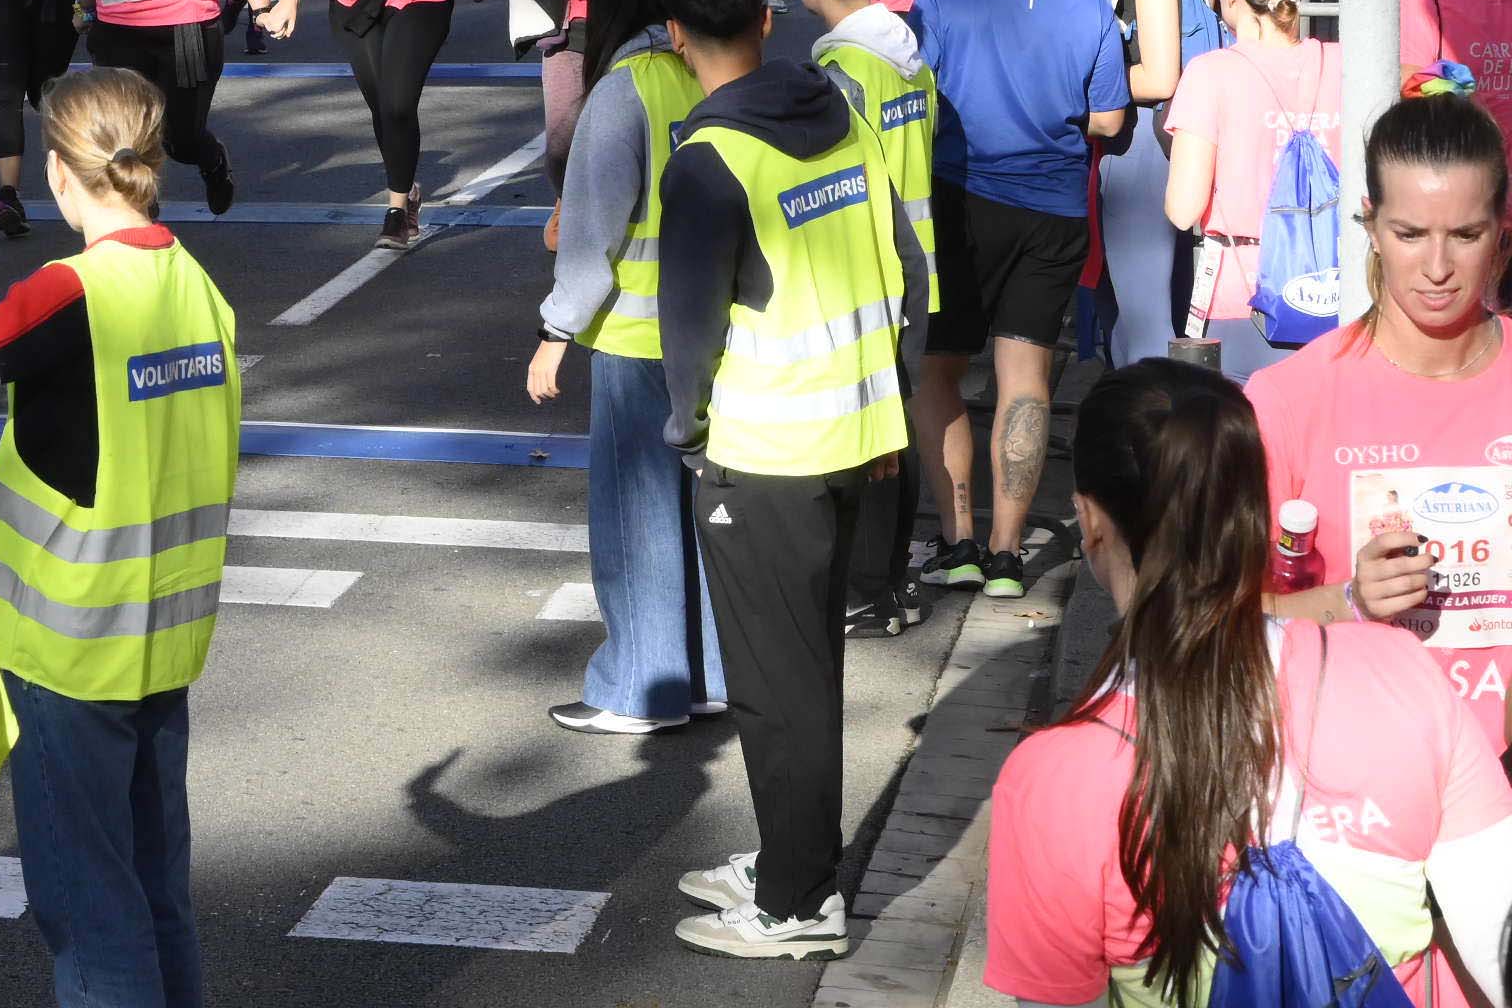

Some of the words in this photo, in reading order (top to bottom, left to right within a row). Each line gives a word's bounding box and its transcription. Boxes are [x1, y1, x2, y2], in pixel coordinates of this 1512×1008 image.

[782, 175, 867, 219] VOLUNTARIS
[131, 354, 223, 390] VOLUNTARIS
[1335, 443, 1421, 466] OYSHO
[1420, 498, 1492, 514] ASTURIANA
[1425, 539, 1491, 564] 016
[1455, 596, 1470, 607] LA
[1470, 594, 1507, 606] MUJER
